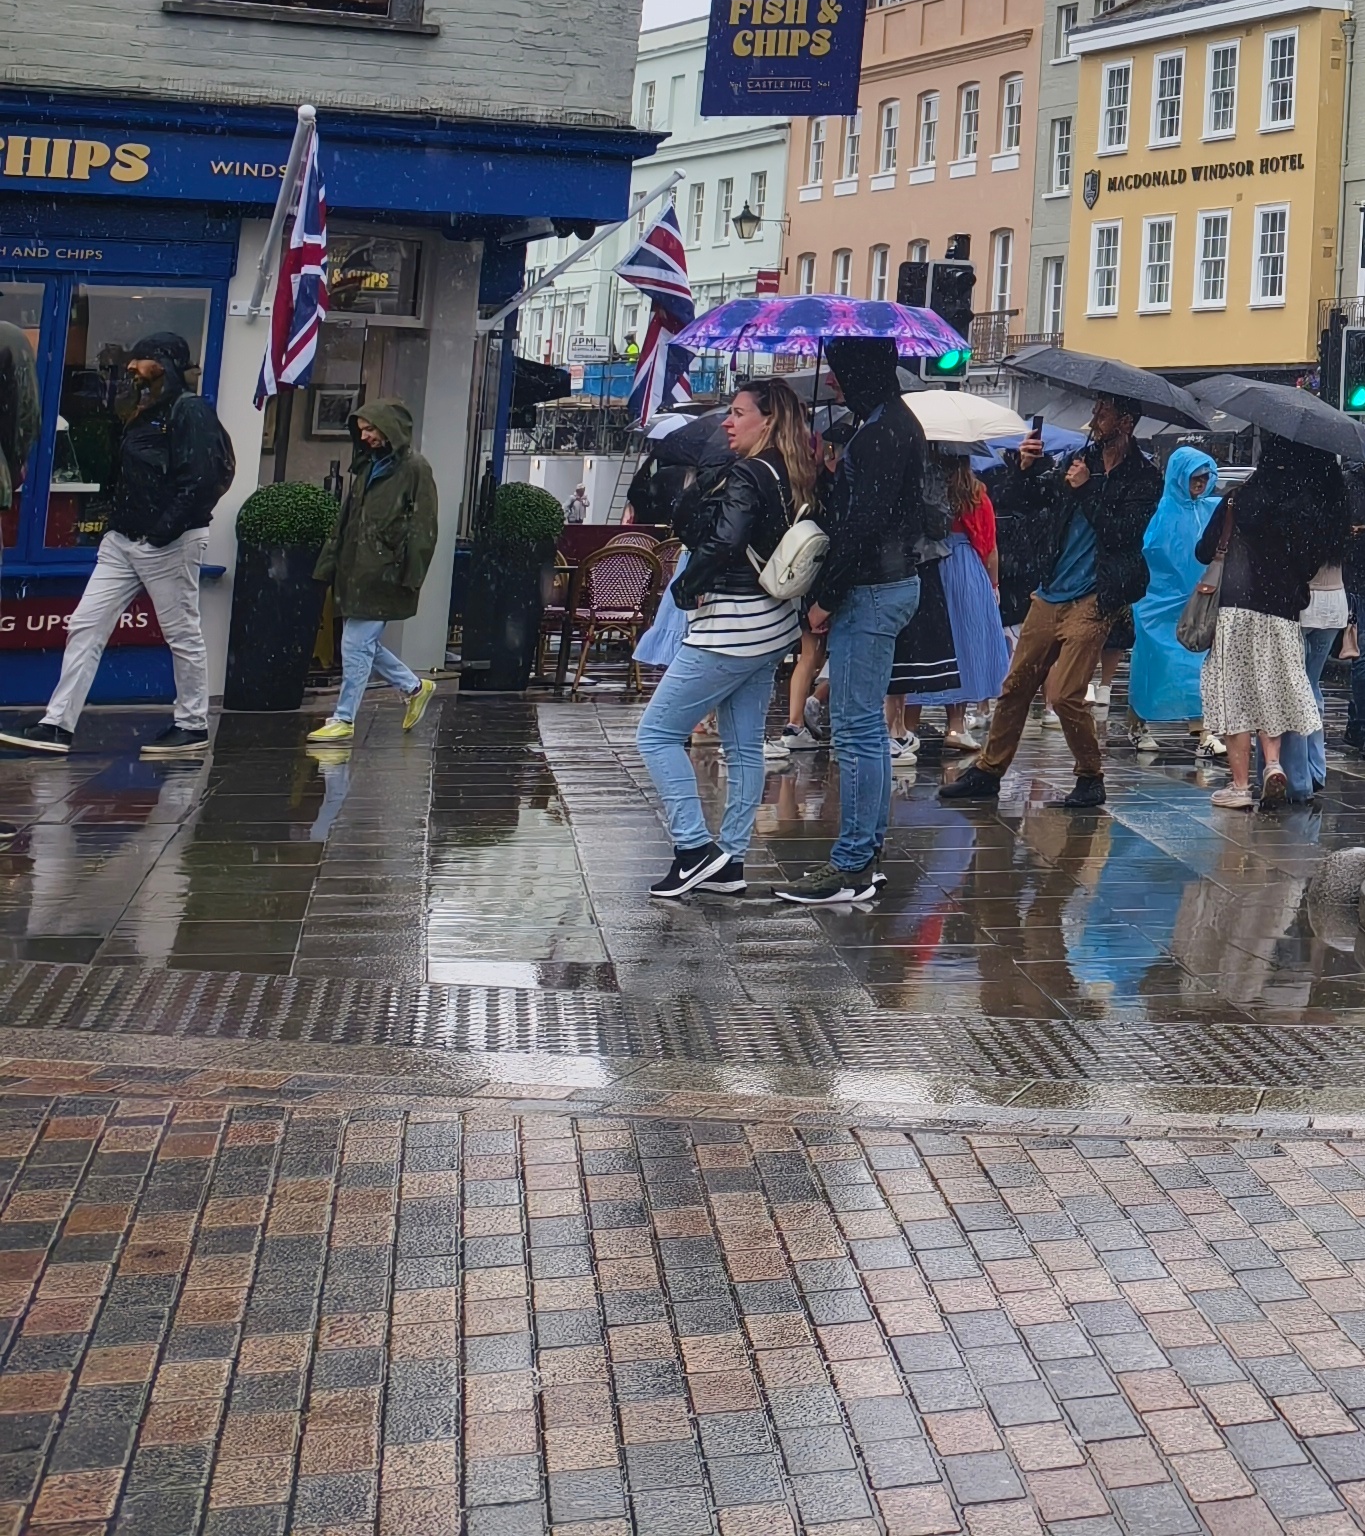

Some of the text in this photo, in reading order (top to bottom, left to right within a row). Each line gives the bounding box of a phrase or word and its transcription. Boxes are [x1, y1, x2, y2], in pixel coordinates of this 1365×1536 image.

[732, 29, 832, 57] CHIPS
[747, 80, 784, 89] CASTLE
[790, 80, 811, 89] HILL
[0, 135, 288, 182] HIPS WINDS
[1107, 153, 1305, 193] MACDONALD WINDSOR HOTEL
[12, 247, 49, 259] AND
[55, 248, 103, 261] CHIPS
